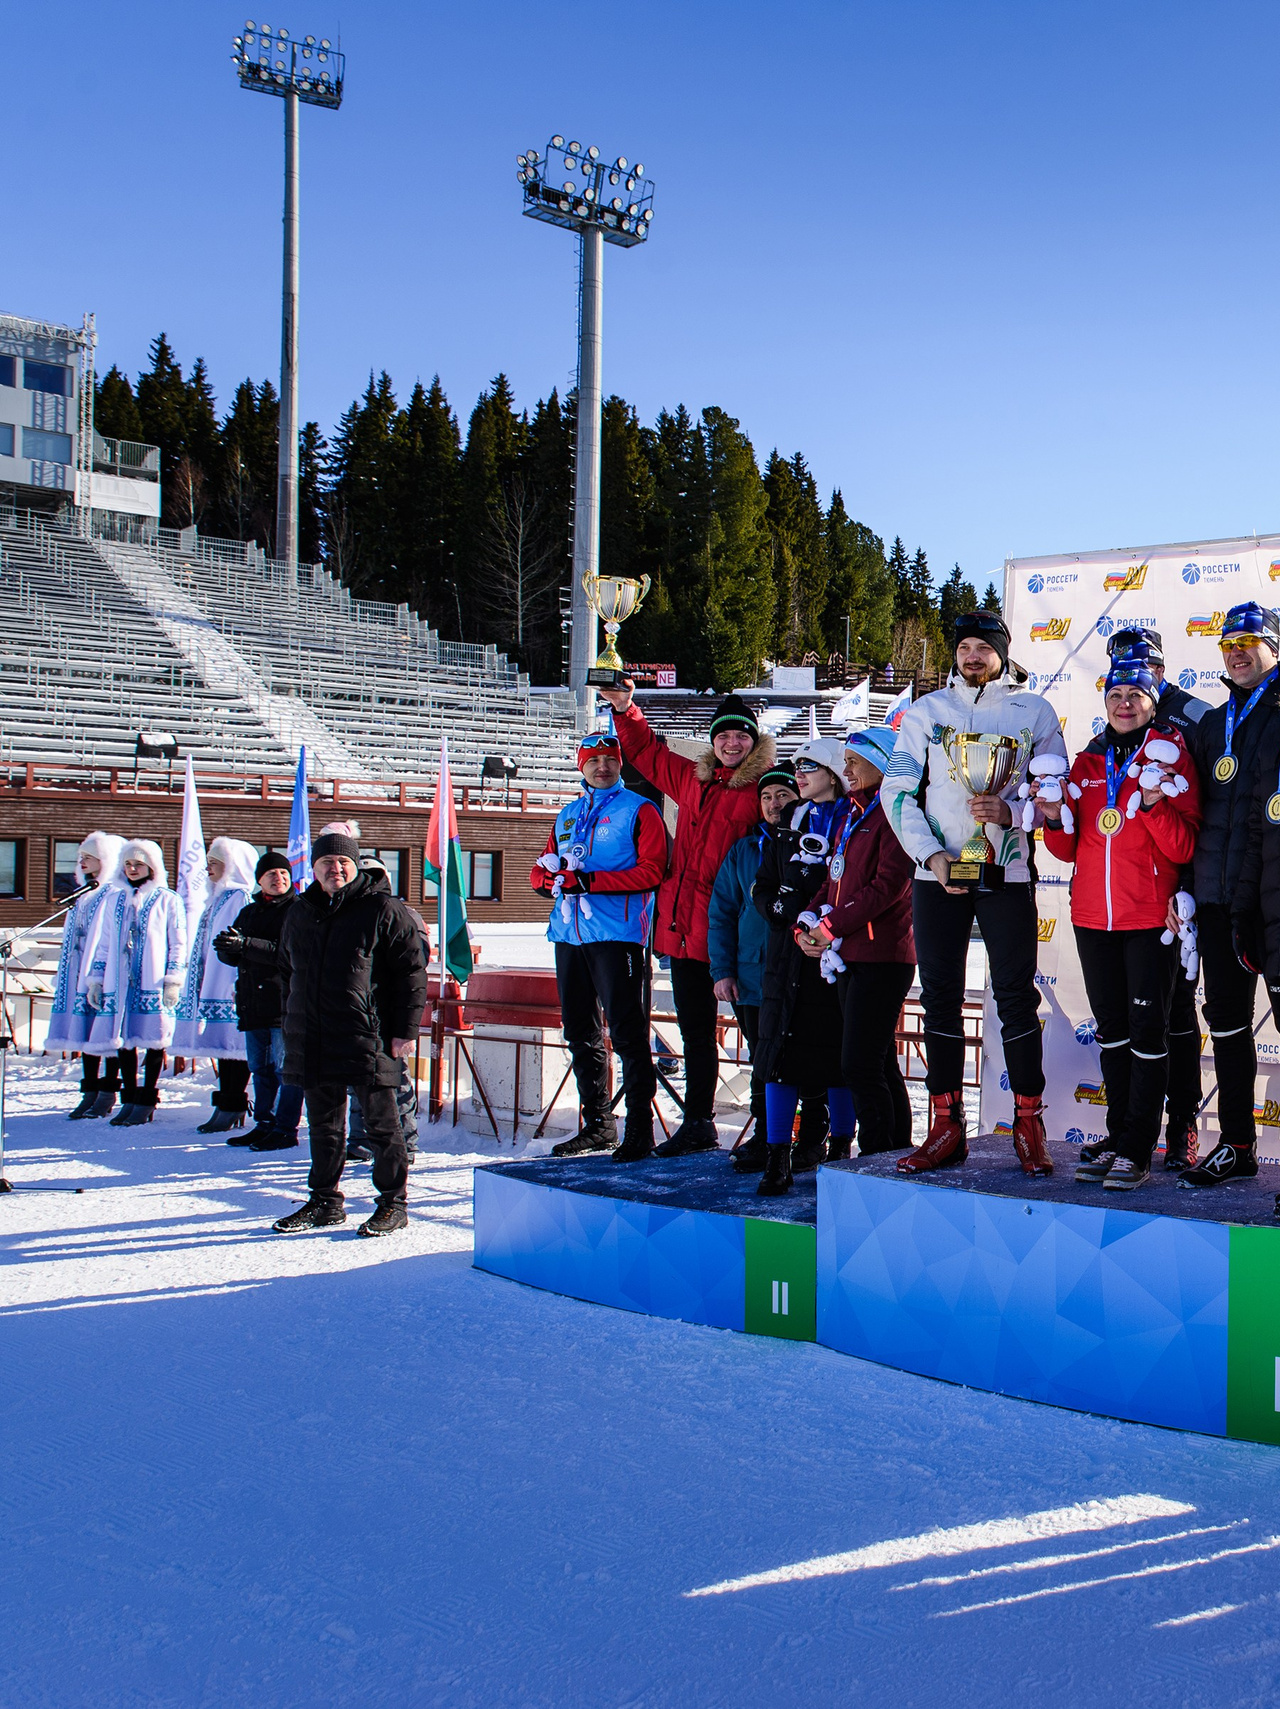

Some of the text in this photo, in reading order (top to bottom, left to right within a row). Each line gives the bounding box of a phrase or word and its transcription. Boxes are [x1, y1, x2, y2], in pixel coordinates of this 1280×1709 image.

[1203, 564, 1240, 574] РОССЕТИ
[1047, 574, 1078, 584] РОССЕТИ
[1117, 618, 1156, 627] РОССЕТИ
[1209, 611, 1226, 630] ВЭ
[640, 662, 676, 670] ТРИБУНА
[660, 673, 674, 684] NE
[1040, 673, 1071, 682] РОССЕТИ
[1200, 671, 1227, 679] РОССЕ
[1038, 875, 1061, 884] ССЕТИ
[1034, 975, 1057, 985] СЕТИ
[927, 1130, 952, 1155] alpina
[1018, 1132, 1030, 1158] alpina
